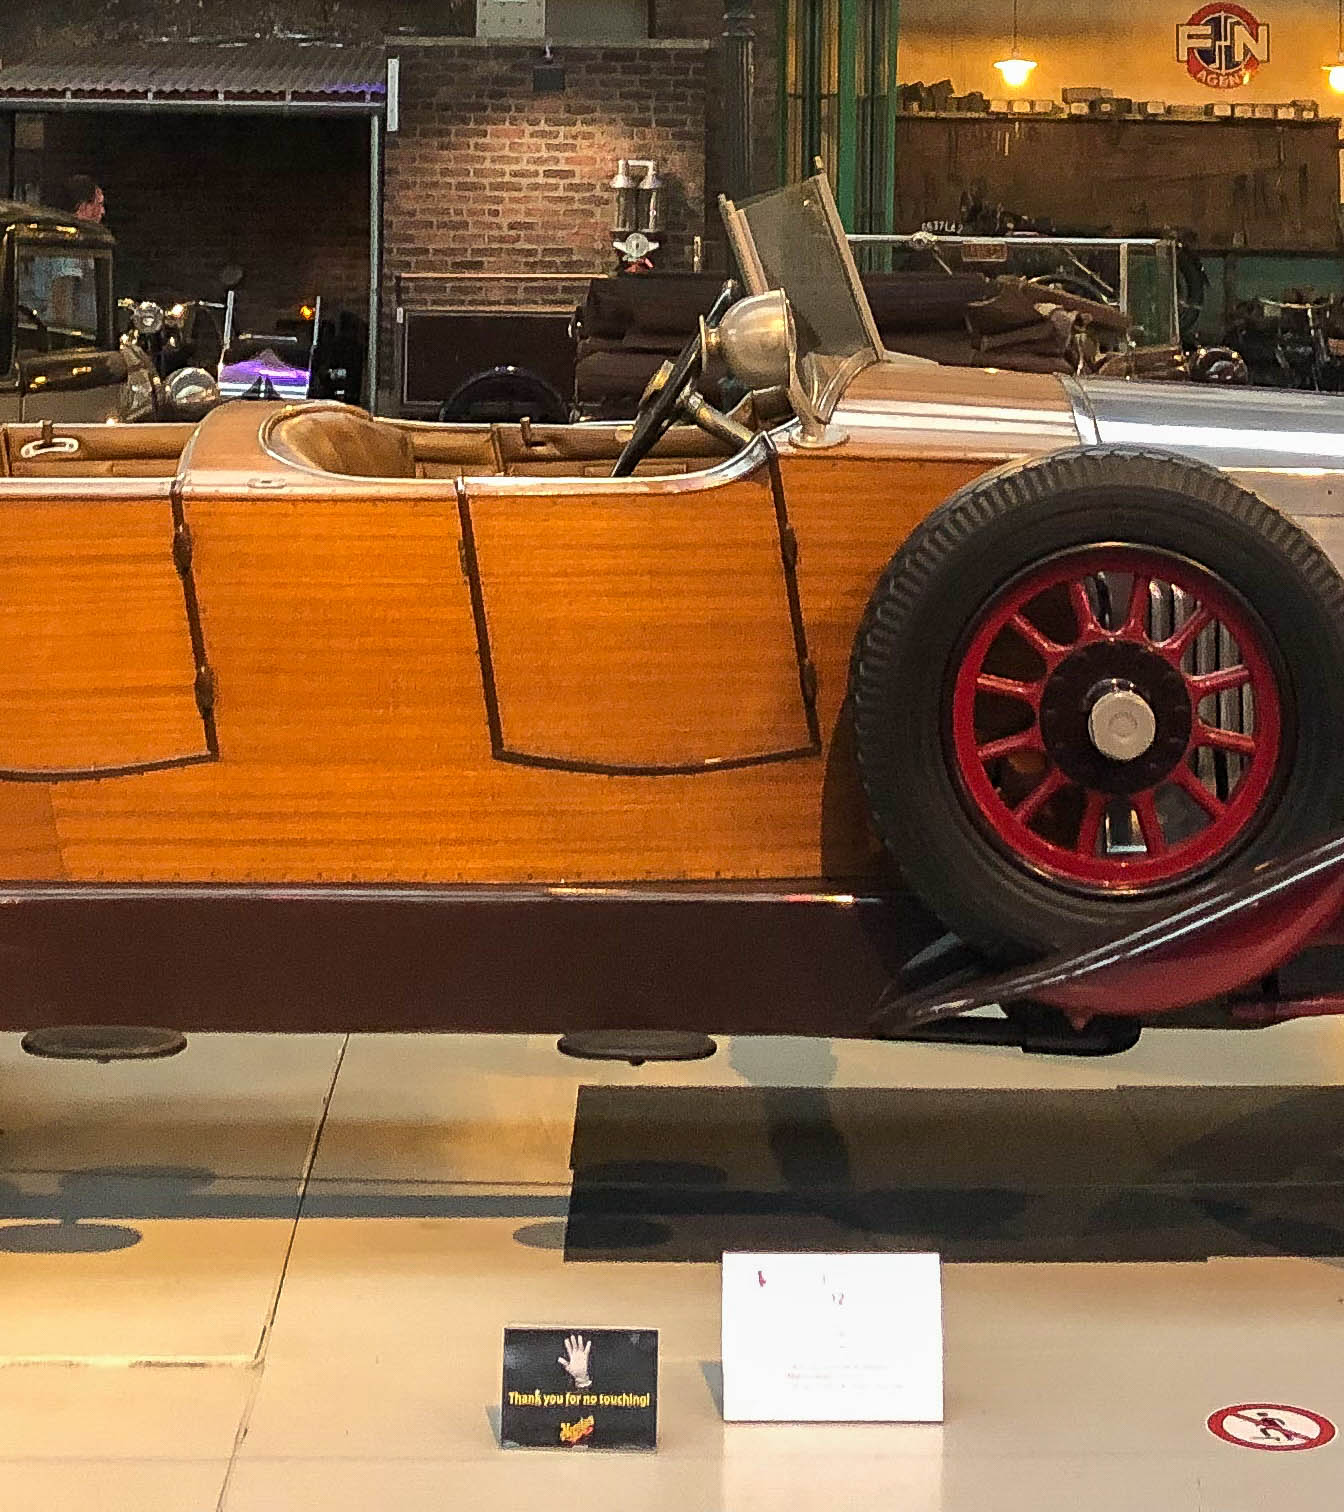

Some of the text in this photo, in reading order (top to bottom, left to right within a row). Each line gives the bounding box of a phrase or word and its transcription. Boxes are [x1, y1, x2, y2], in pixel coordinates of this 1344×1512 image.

[508, 1390, 650, 1407] Thank you for no touching!
